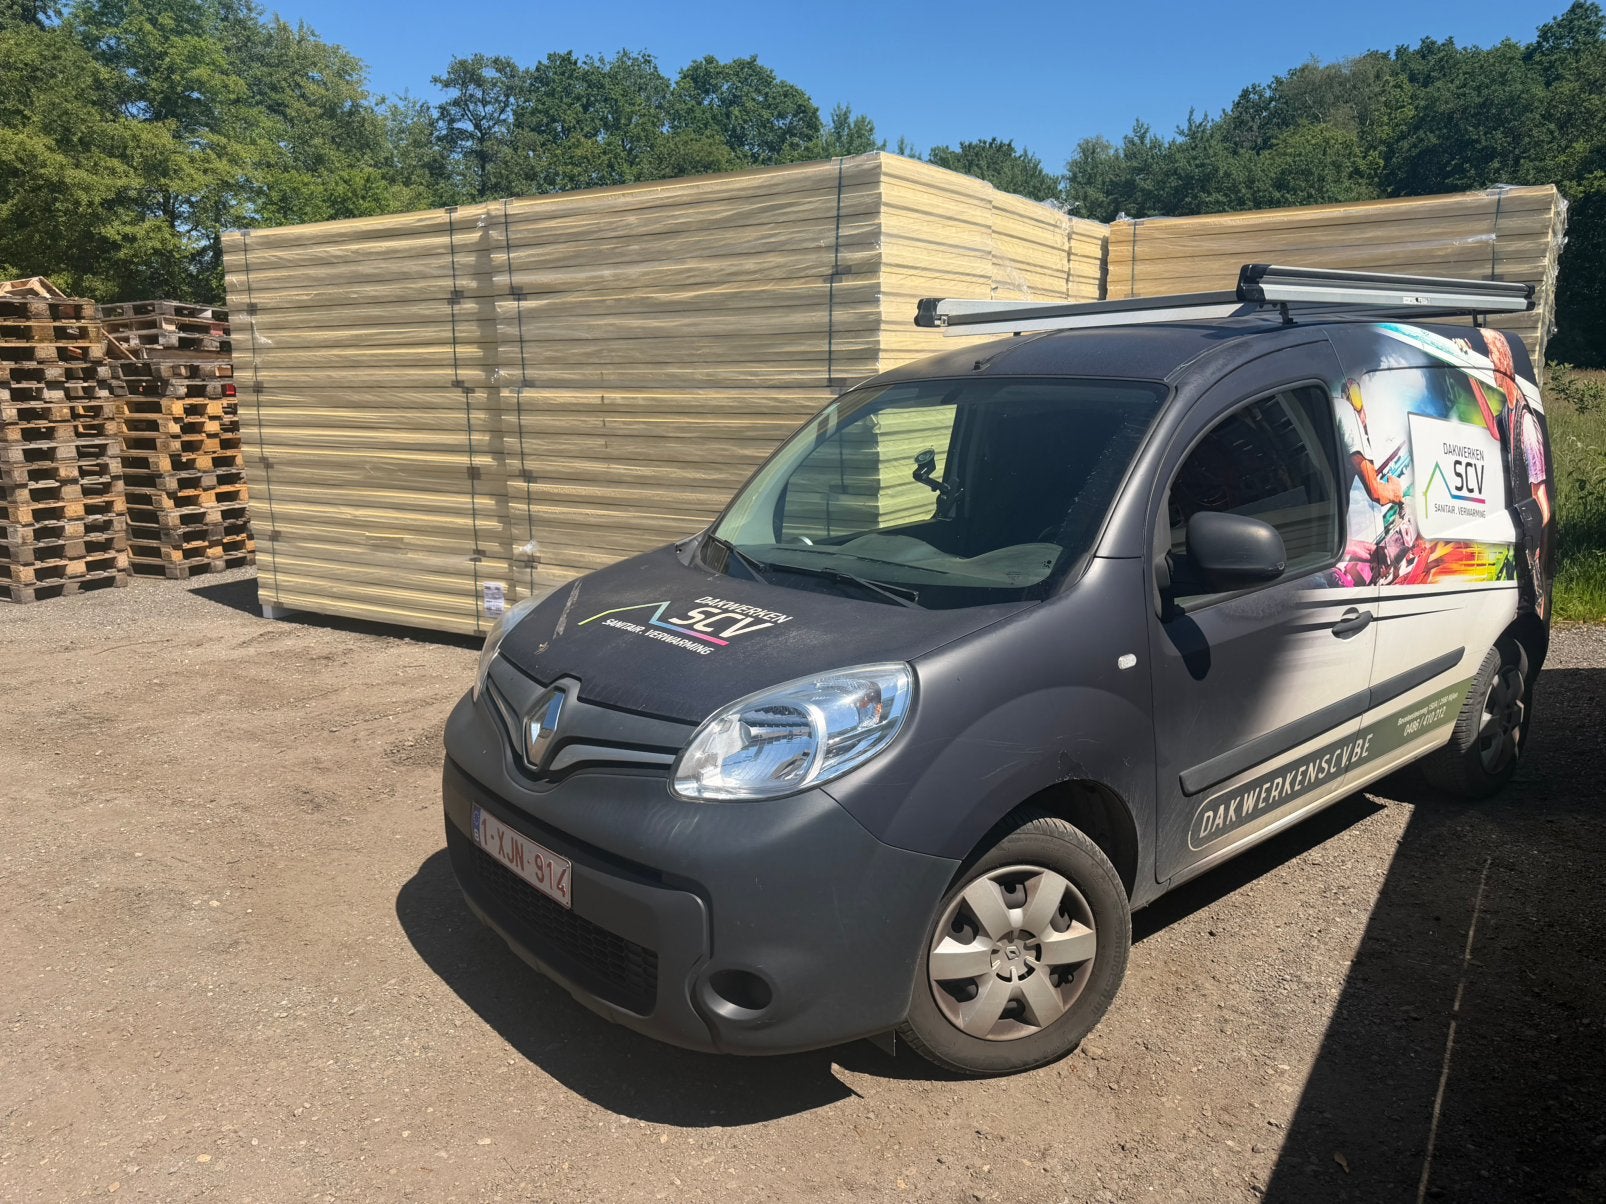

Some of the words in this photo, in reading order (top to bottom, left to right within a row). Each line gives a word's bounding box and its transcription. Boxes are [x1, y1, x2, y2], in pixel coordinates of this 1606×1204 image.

[1442, 442, 1484, 461] DAKWERKEN
[1453, 459, 1484, 495] SCV
[668, 607, 775, 638] SCV
[694, 596, 794, 624] DAKWERKEN
[644, 629, 715, 655] VERWARMING
